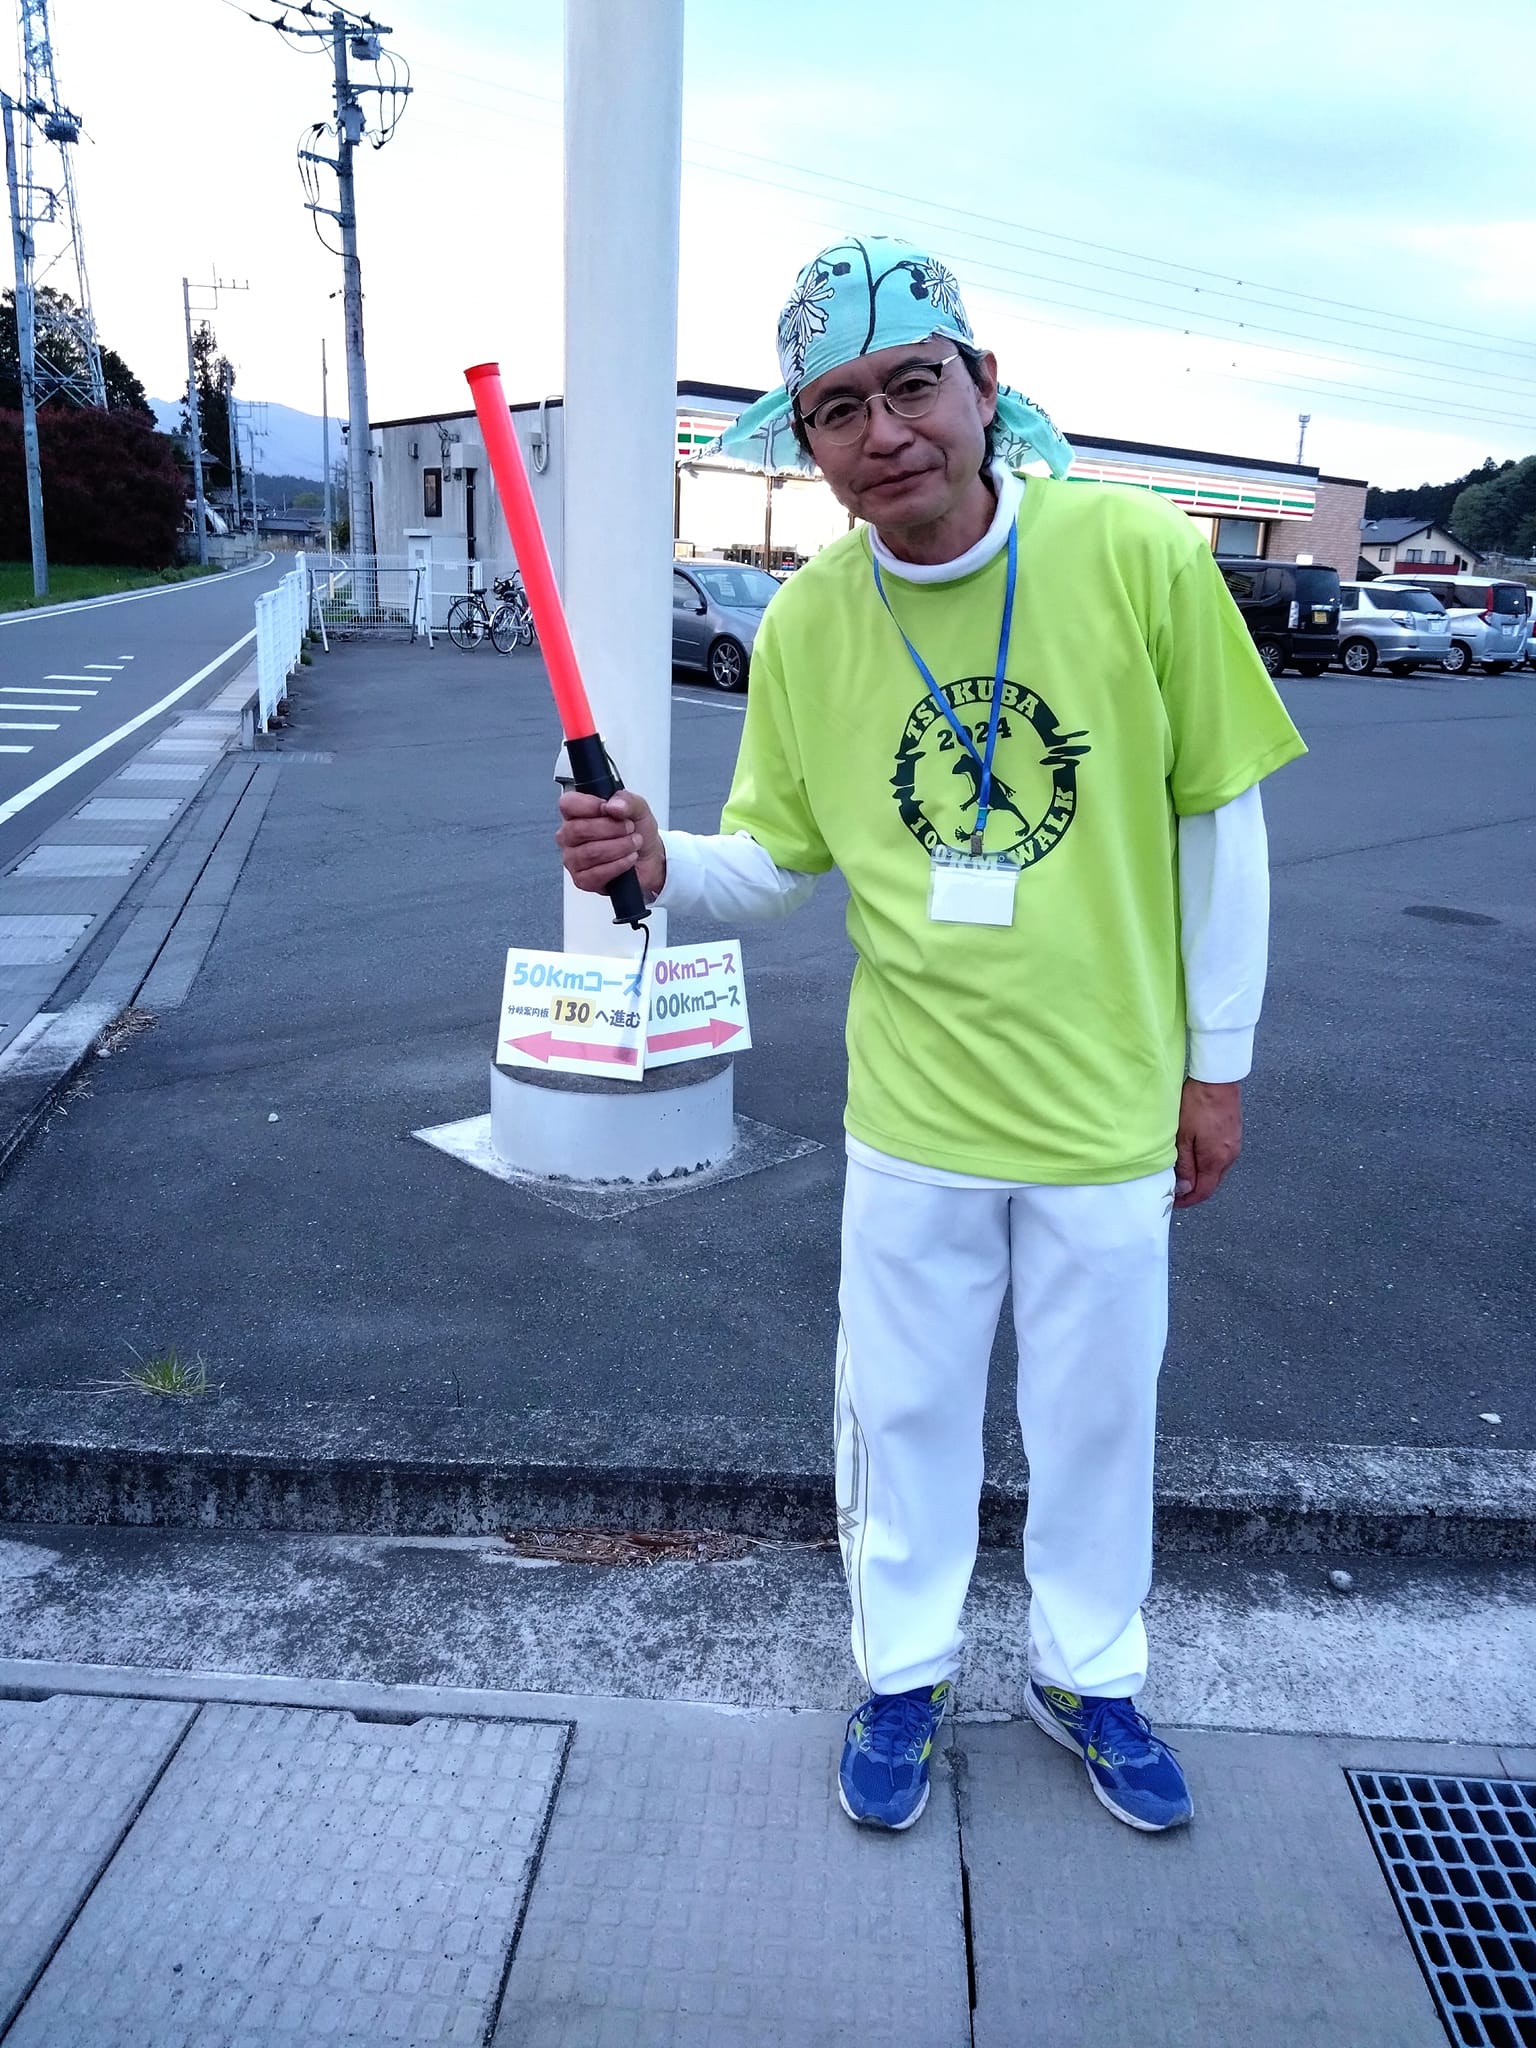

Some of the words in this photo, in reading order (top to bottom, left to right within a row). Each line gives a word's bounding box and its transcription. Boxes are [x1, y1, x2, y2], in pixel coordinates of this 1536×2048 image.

[937, 717, 1012, 752] 2024
[1007, 786, 1074, 865] WALK
[655, 953, 736, 985] 0kmコース
[554, 1000, 590, 1023] 130
